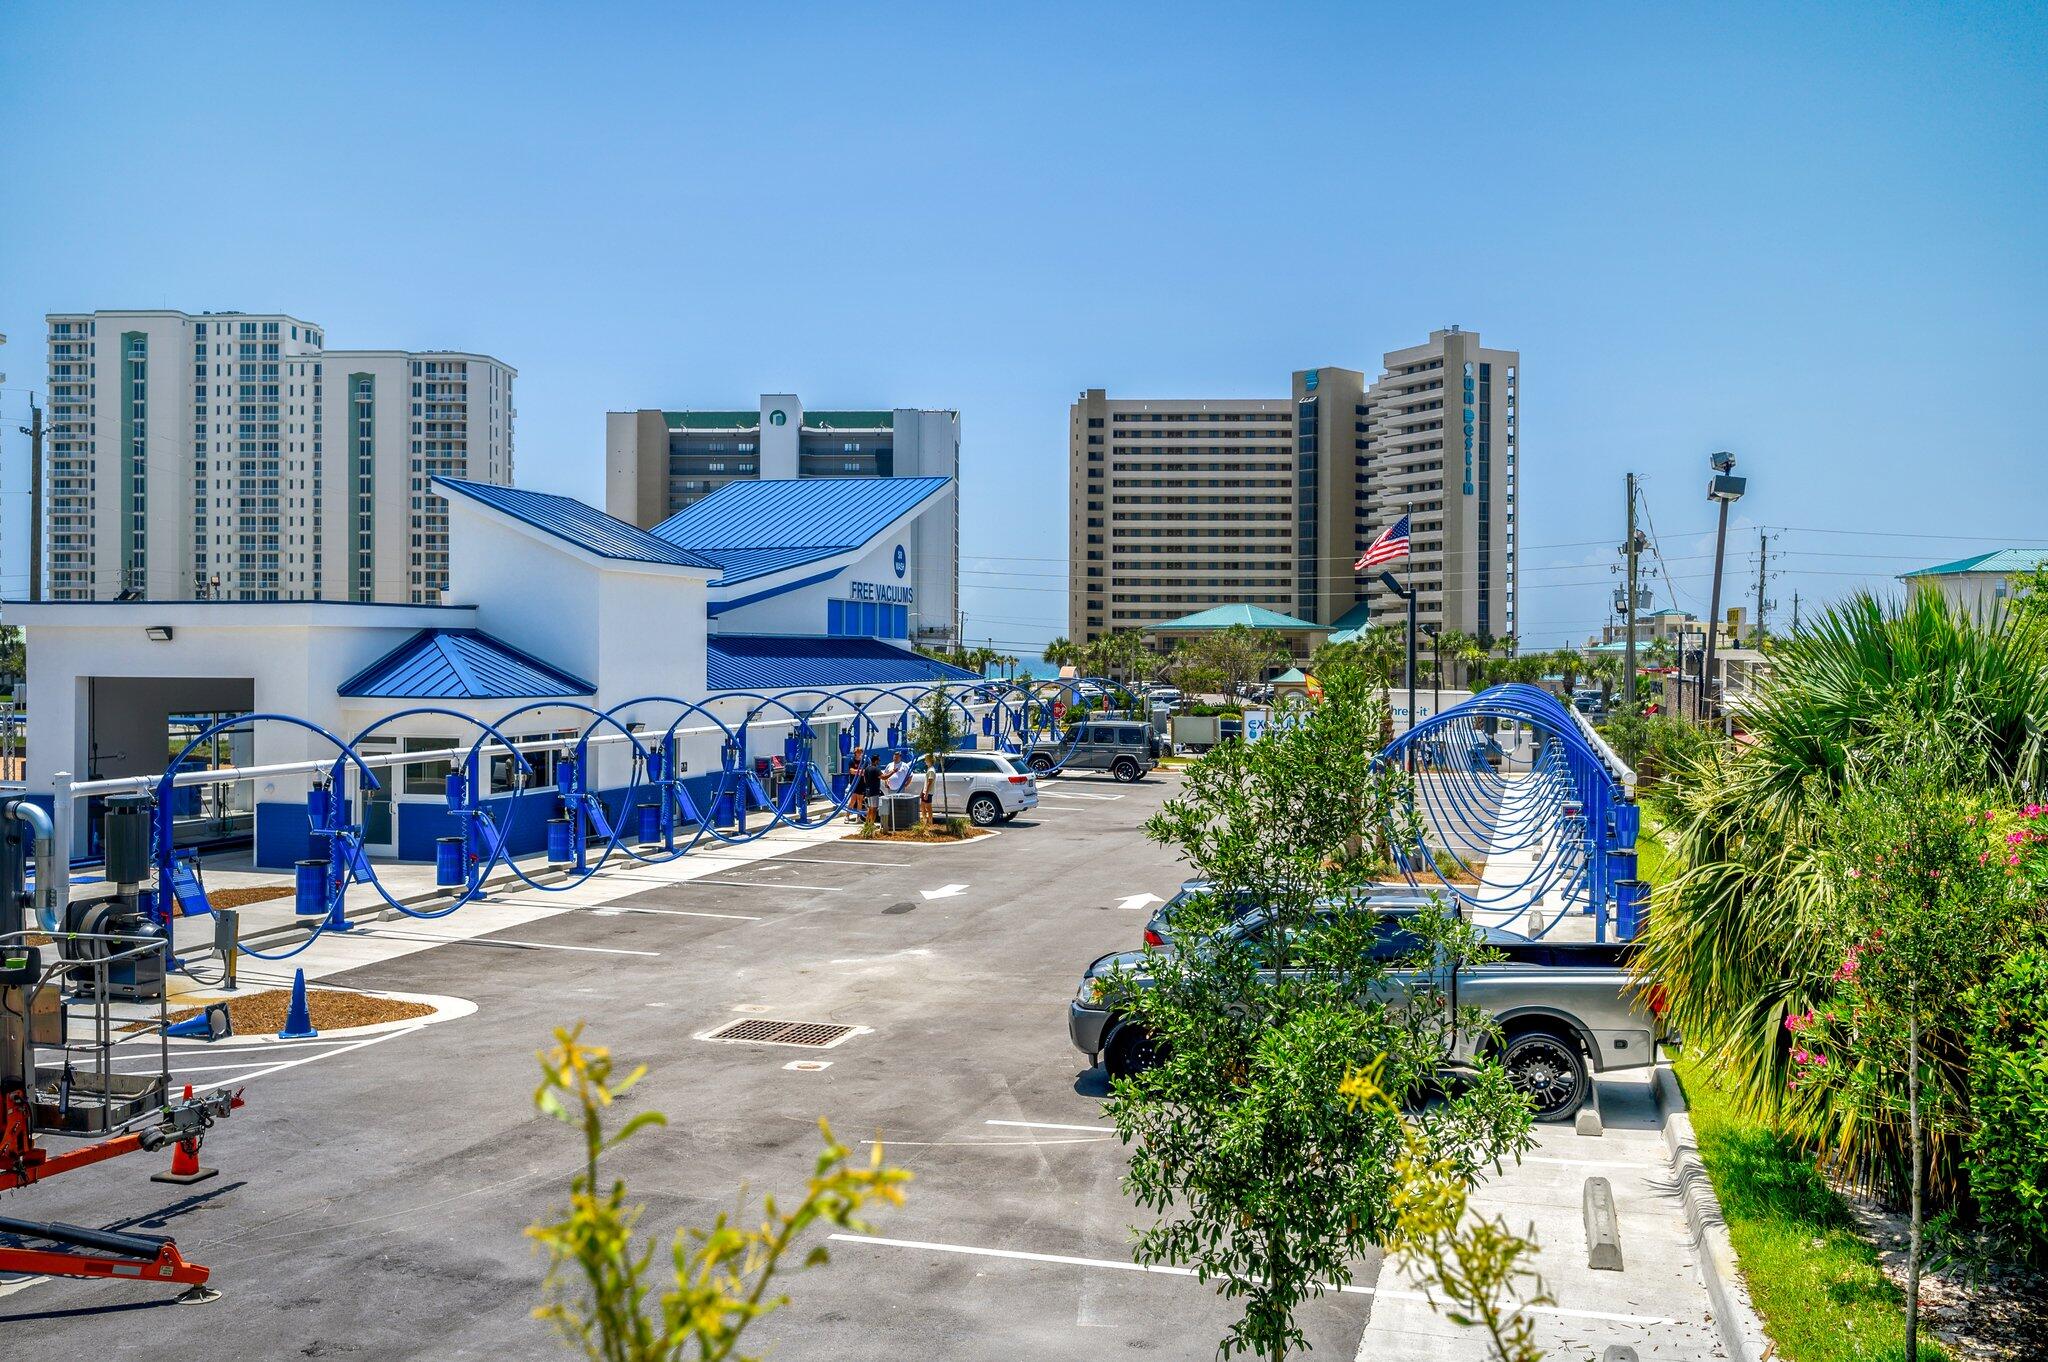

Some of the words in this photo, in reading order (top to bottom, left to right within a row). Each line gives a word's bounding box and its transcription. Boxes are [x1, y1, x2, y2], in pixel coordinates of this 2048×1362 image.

[1463, 361, 1475, 405] Sun
[851, 581, 874, 600] FREE
[876, 584, 914, 604] VACUUMS
[1390, 704, 1428, 717] hre-it
